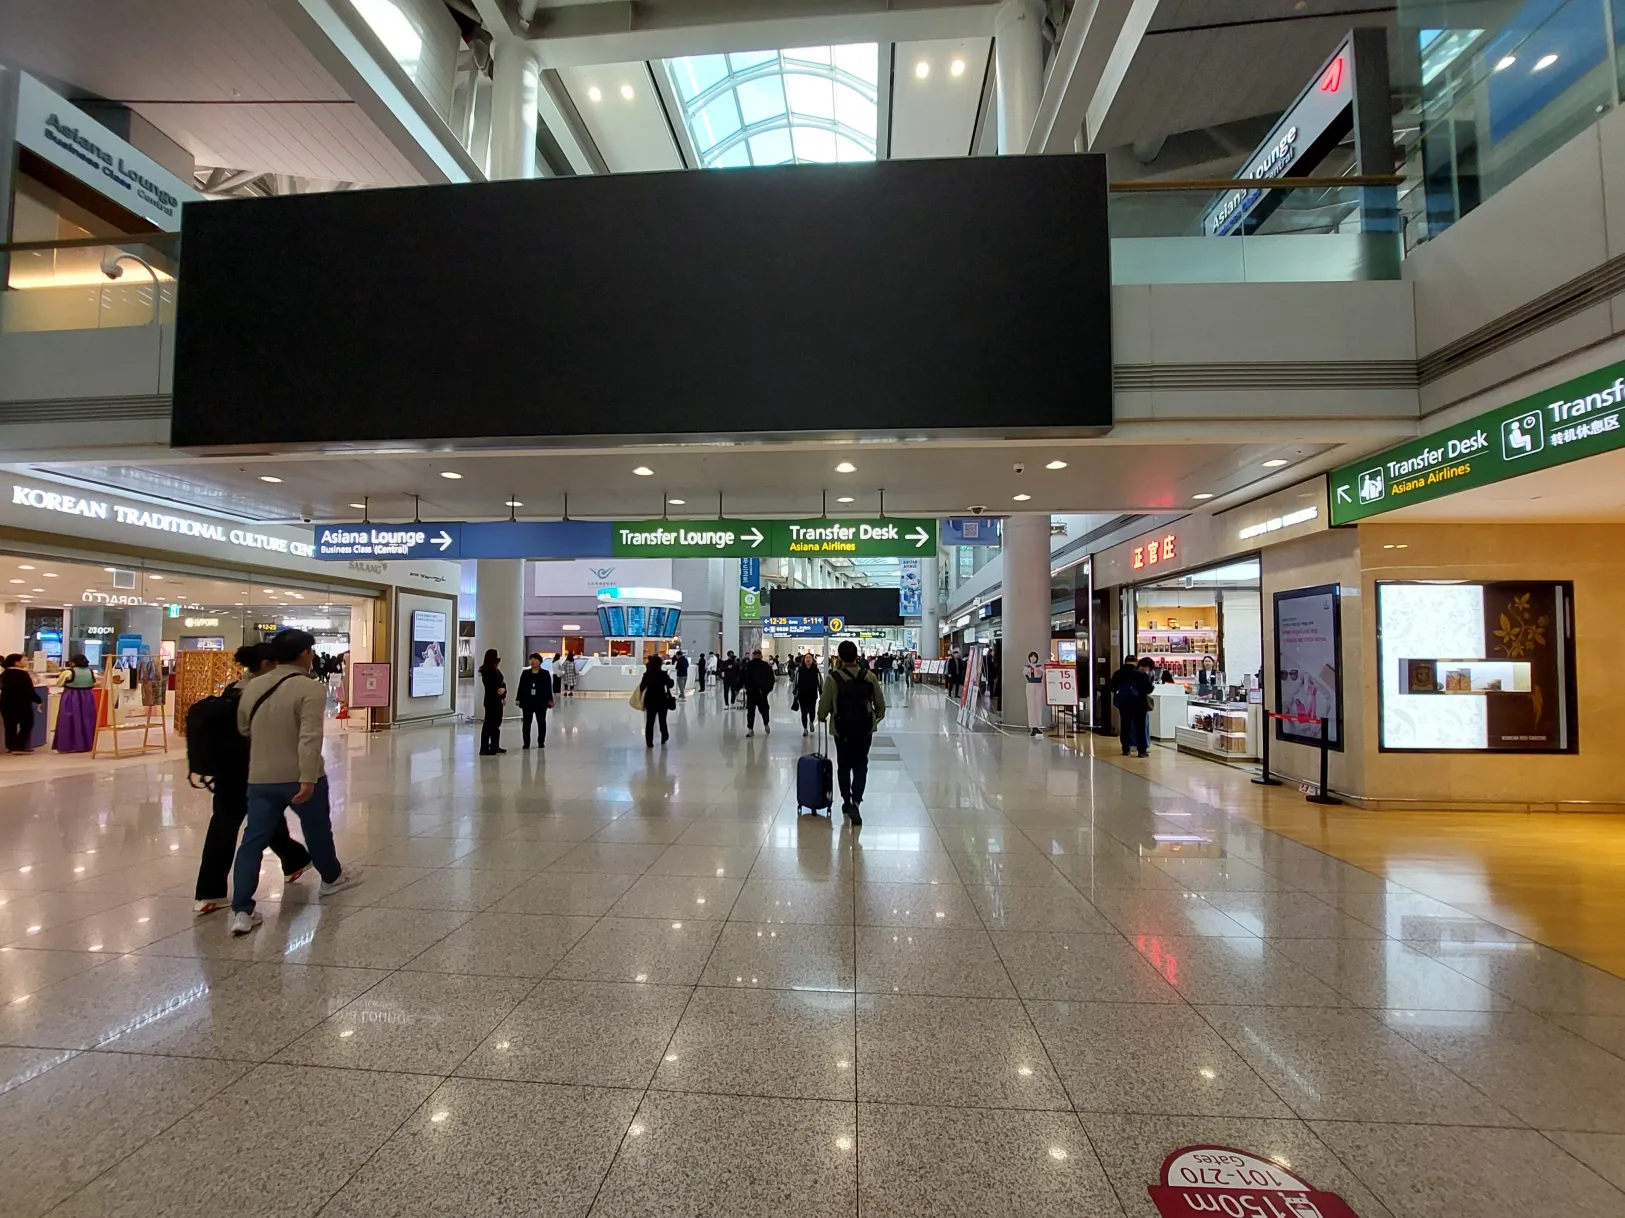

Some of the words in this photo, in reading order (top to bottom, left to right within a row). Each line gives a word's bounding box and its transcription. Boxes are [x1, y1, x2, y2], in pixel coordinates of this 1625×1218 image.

[45, 113, 113, 166] Asiana
[118, 158, 178, 208] Lounge
[137, 189, 173, 217] Central
[1548, 377, 1625, 423] Transf
[1550, 414, 1620, 447] 转机休息区
[1387, 446, 1444, 478] Transfer
[1448, 429, 1489, 458] Desk
[1391, 477, 1425, 495] Asiana
[1427, 462, 1471, 485] Airlines
[12, 485, 107, 519] KOREAN
[114, 505, 226, 541] TRADITIONAL
[229, 529, 287, 553] CULTURE
[320, 529, 369, 544] Asiana
[370, 529, 425, 547] Lounge
[619, 529, 675, 546] Transfer
[680, 528, 735, 548] Lounge
[789, 524, 855, 541] Transfer
[860, 524, 899, 541] Desk
[321, 545, 352, 554] Business
[353, 545, 372, 554] Class
[789, 542, 820, 552] Asiana
[821, 542, 856, 552] Airlines
[1133, 534, 1177, 569] 正官庄
[769, 617, 787, 625] 12-25
[1192, 1154, 1246, 1168] Gates
[1180, 1167, 1282, 1187] 101-270
